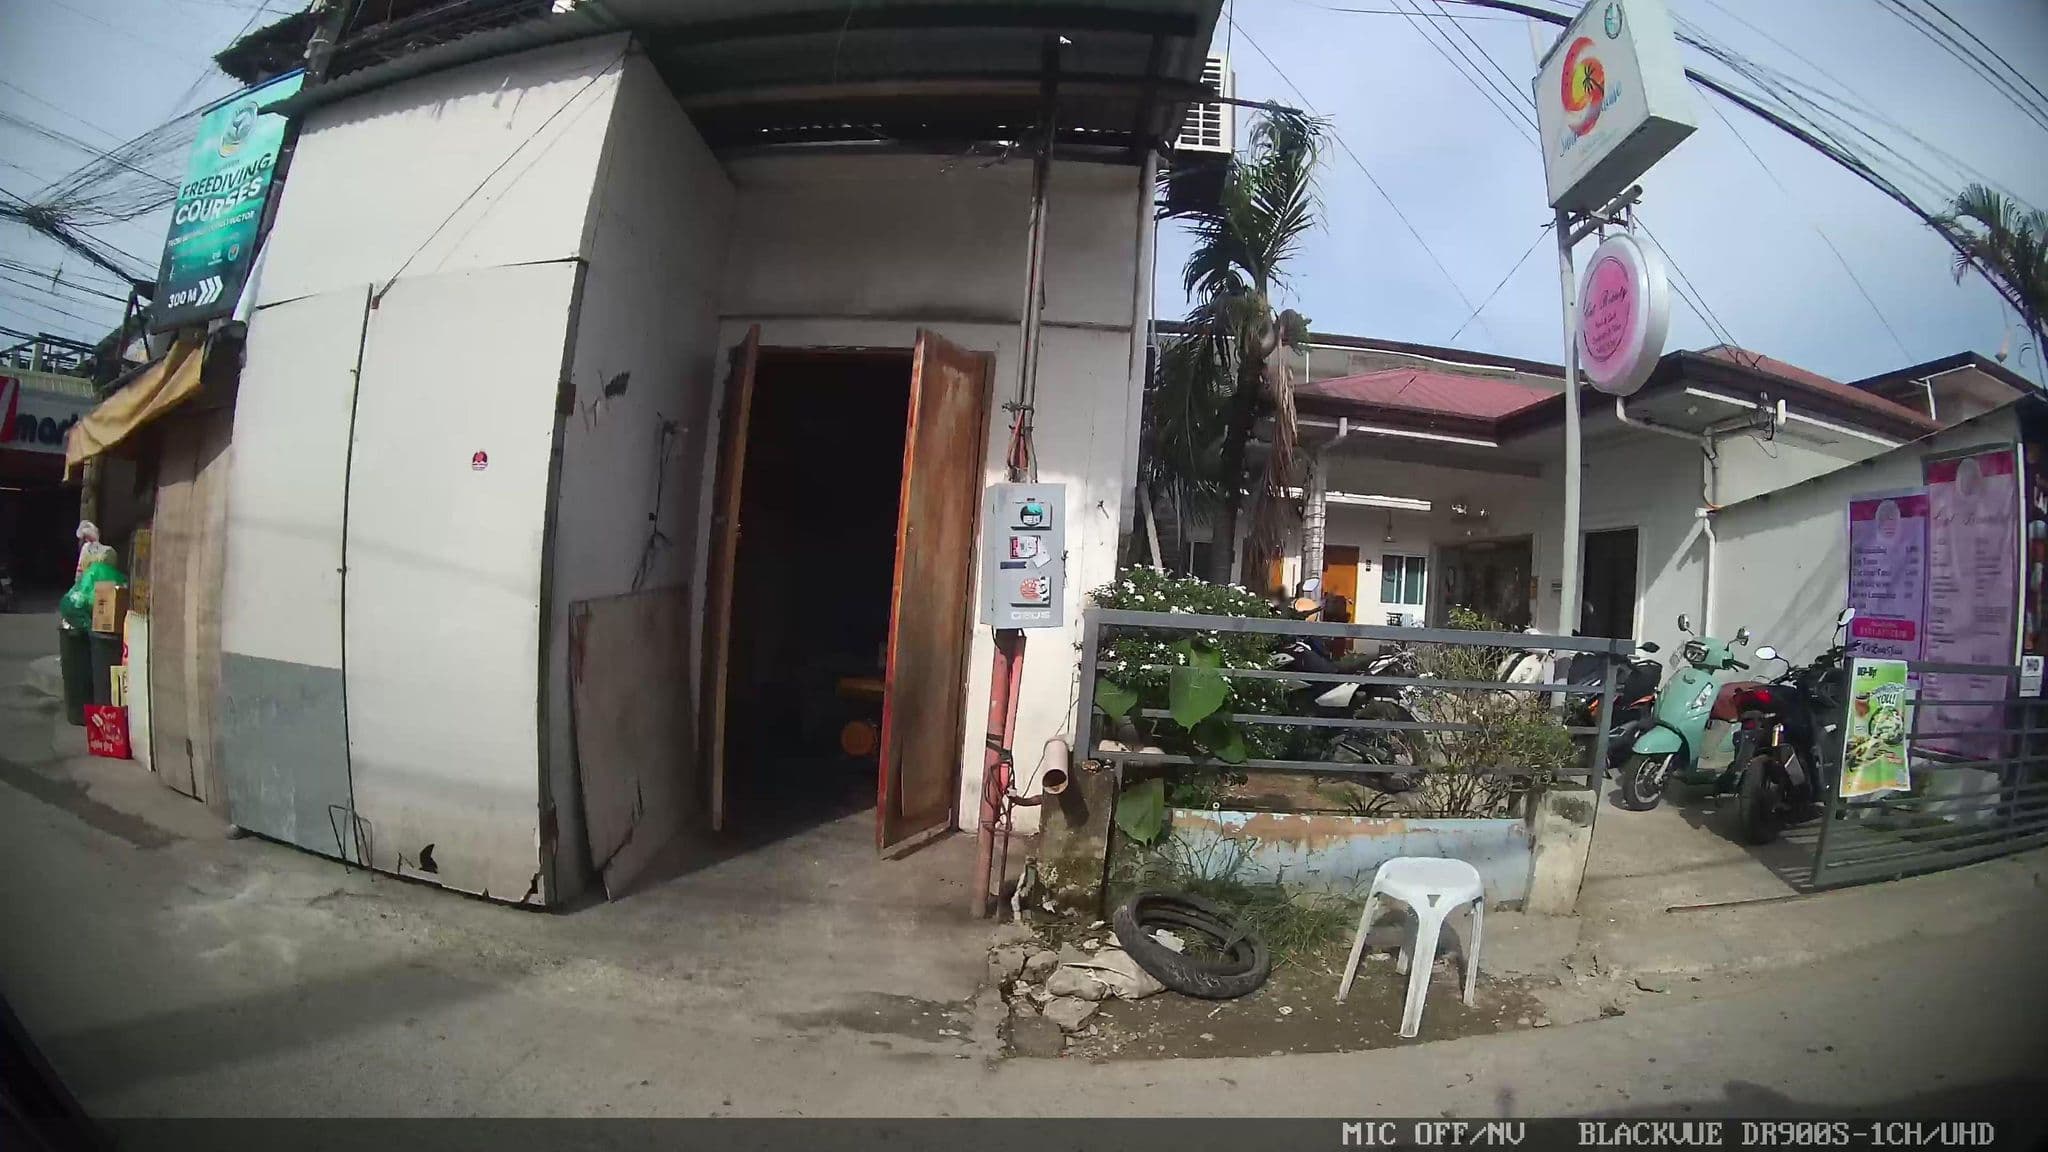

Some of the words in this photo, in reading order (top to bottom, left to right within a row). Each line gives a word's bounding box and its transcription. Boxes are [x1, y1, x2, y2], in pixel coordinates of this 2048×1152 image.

[182, 153, 271, 198] FREEDIVING
[175, 176, 264, 225] COURSES
[167, 290, 187, 309] 300
[187, 287, 198, 304] M
[16, 413, 79, 446] mar
